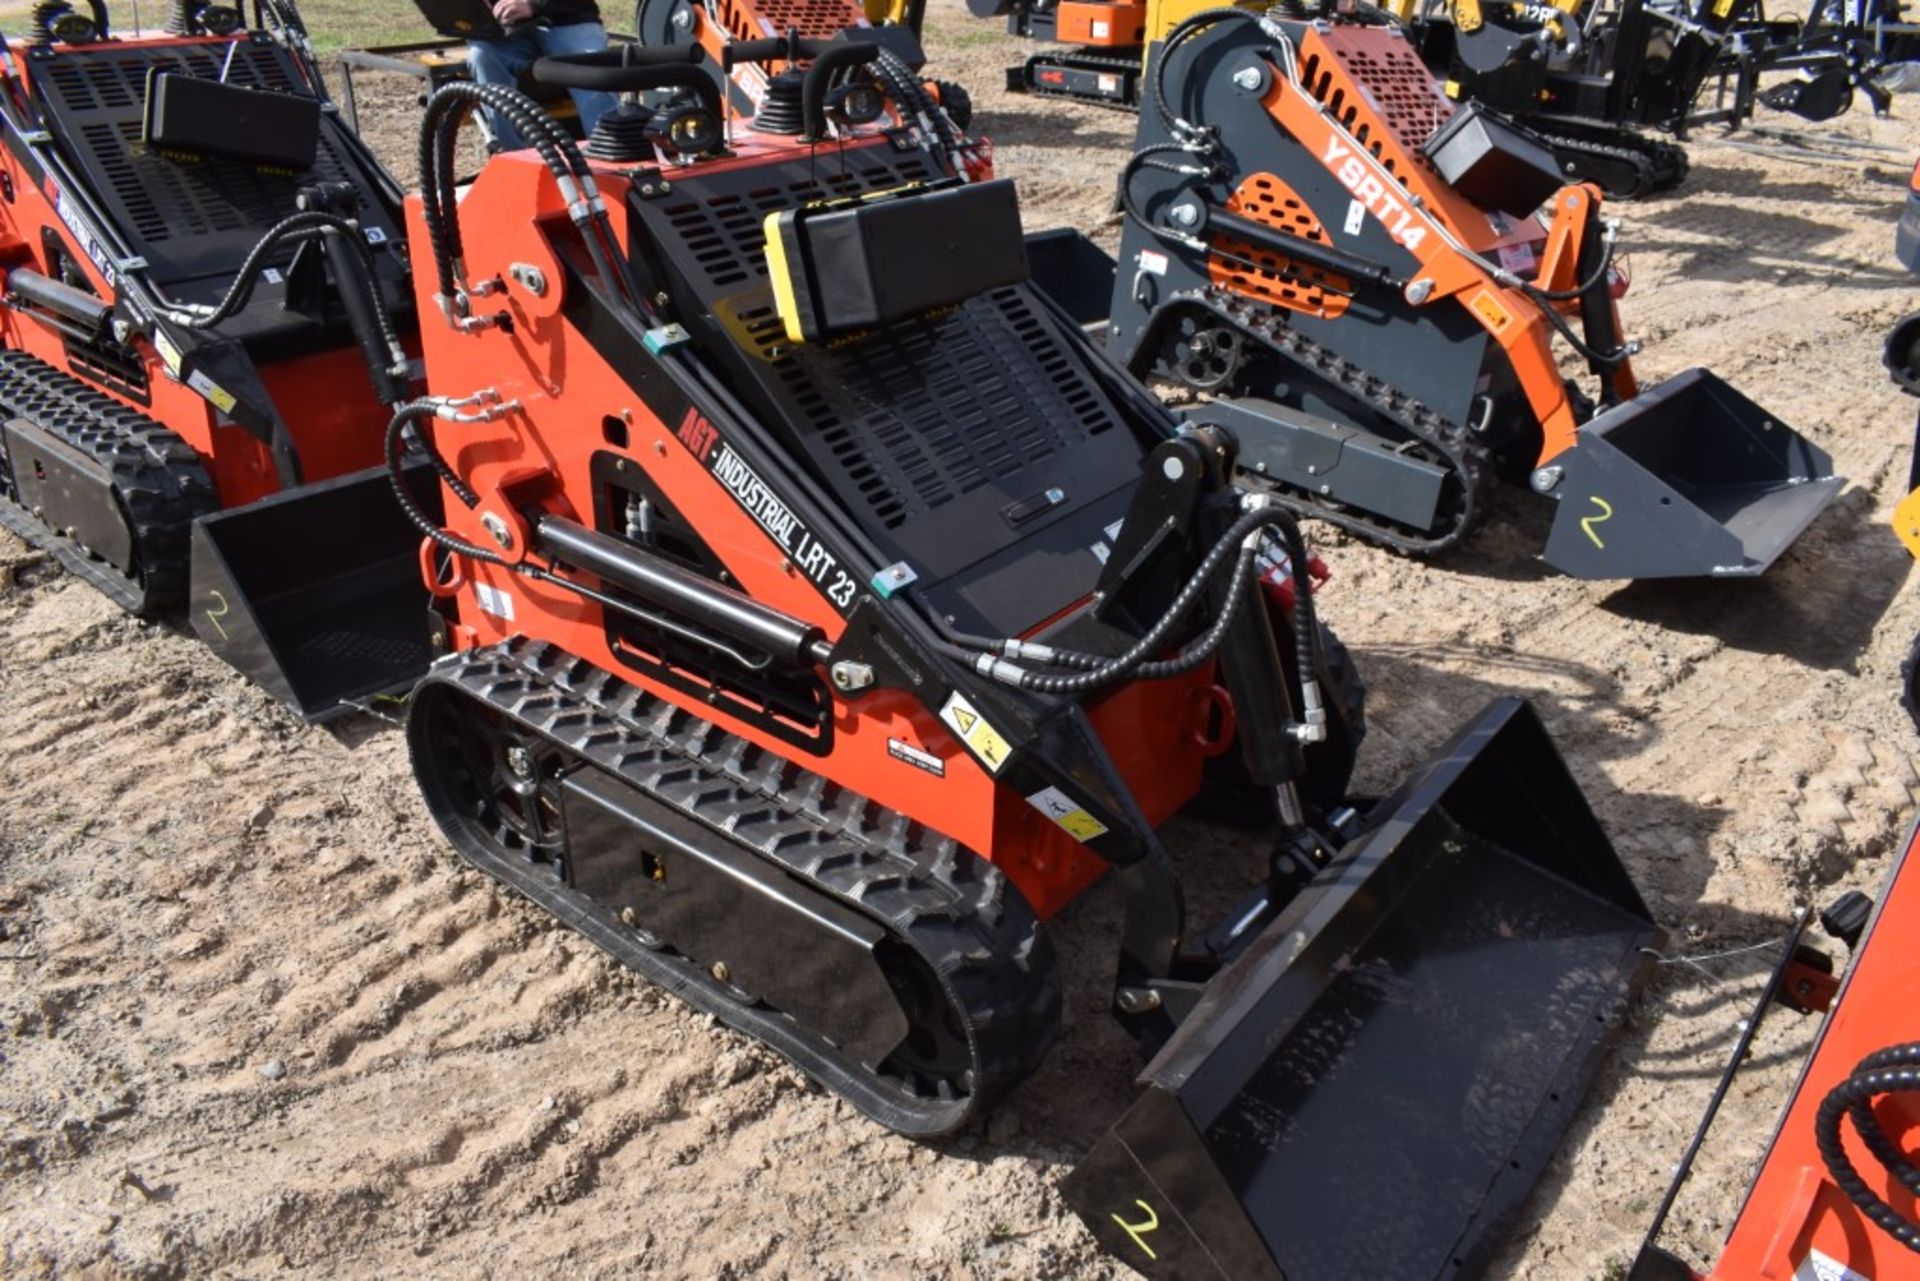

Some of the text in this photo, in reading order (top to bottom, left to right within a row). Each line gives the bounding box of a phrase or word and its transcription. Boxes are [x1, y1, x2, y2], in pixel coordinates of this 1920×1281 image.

[1323, 134, 1427, 249] YSRT14
[678, 406, 719, 462] AGT
[794, 532, 836, 583] LRT
[827, 570, 856, 607] 23
[1581, 496, 1612, 549] 2
[206, 590, 228, 640] 2
[1111, 1199, 1158, 1260] 2
